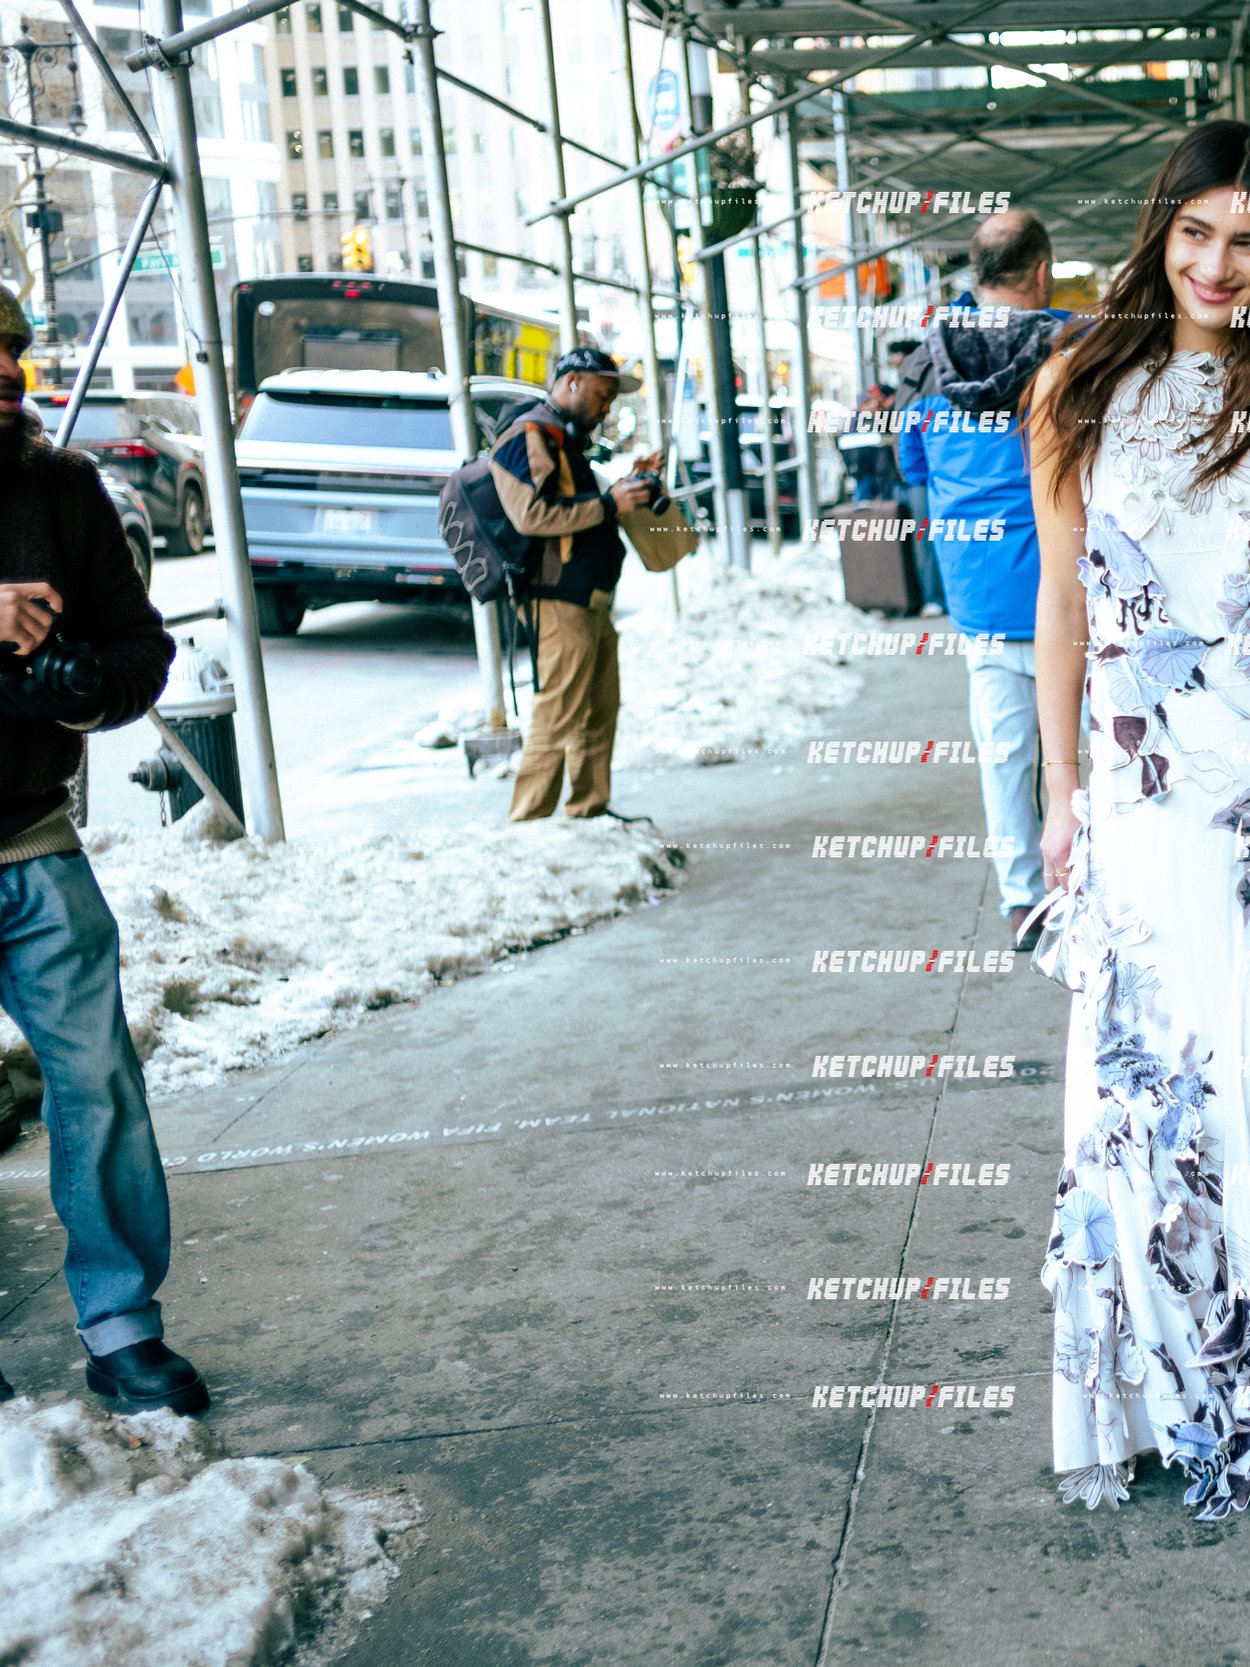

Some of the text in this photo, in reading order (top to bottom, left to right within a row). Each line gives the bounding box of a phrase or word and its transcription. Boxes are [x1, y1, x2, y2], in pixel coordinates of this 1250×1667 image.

[749, 1082, 878, 1105] WOMEN'S
[605, 1097, 741, 1119] NATIONAL
[441, 1121, 503, 1138] FIFA
[301, 1129, 431, 1153] WOMEN'S
[196, 1143, 294, 1163] WORLD
